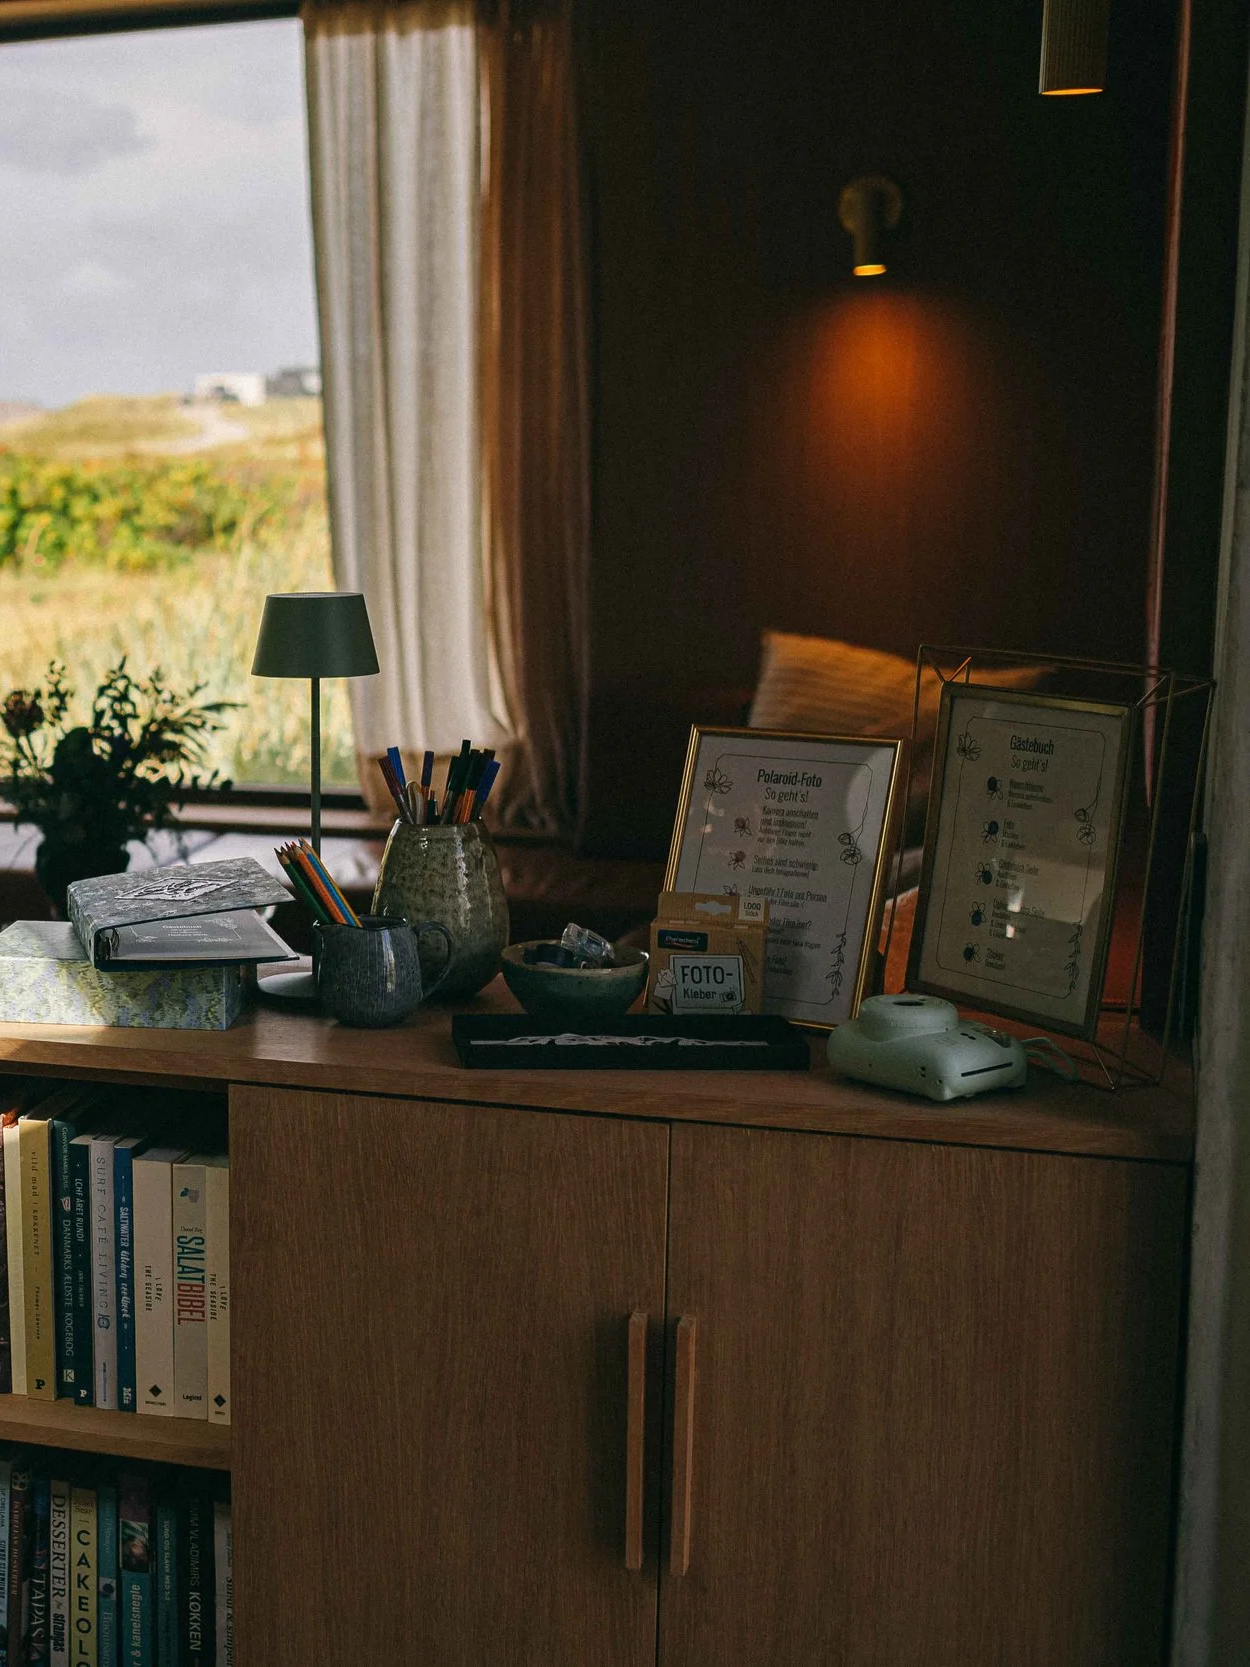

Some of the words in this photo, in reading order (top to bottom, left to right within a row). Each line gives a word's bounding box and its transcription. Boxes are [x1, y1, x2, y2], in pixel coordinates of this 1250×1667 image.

[1010, 735, 1054, 755] Gästebuch
[757, 768, 823, 788] Polaroid-Foto
[764, 786, 776, 800] So
[680, 965, 734, 985] FOTO-
[683, 988, 717, 1000] Kleber
[31, 1151, 39, 1172] vild
[96, 1157, 106, 1195] SURF
[31, 1177, 39, 1197] mad
[74, 1178, 83, 1197] LCHF
[75, 1217, 85, 1242] RUNDT
[119, 1207, 129, 1250] SALTWATER
[62, 1219, 72, 1269] DANMARKS
[119, 1250, 130, 1279] kitchen
[63, 1273, 73, 1307] ÆLDSTE
[98, 1254, 109, 1309] LIVING
[155, 1283, 163, 1301] LOVE
[176, 1235, 206, 1325] SALATBIBEL
[219, 1292, 227, 1311] LOVE
[64, 1312, 75, 1357] KOGEBOG
[52, 1493, 66, 1598] DESSERTER
[30, 1573, 46, 1639] TAPAS
[131, 1584, 143, 1647] kanelsnegle
[188, 1592, 202, 1651] KØKKEN
